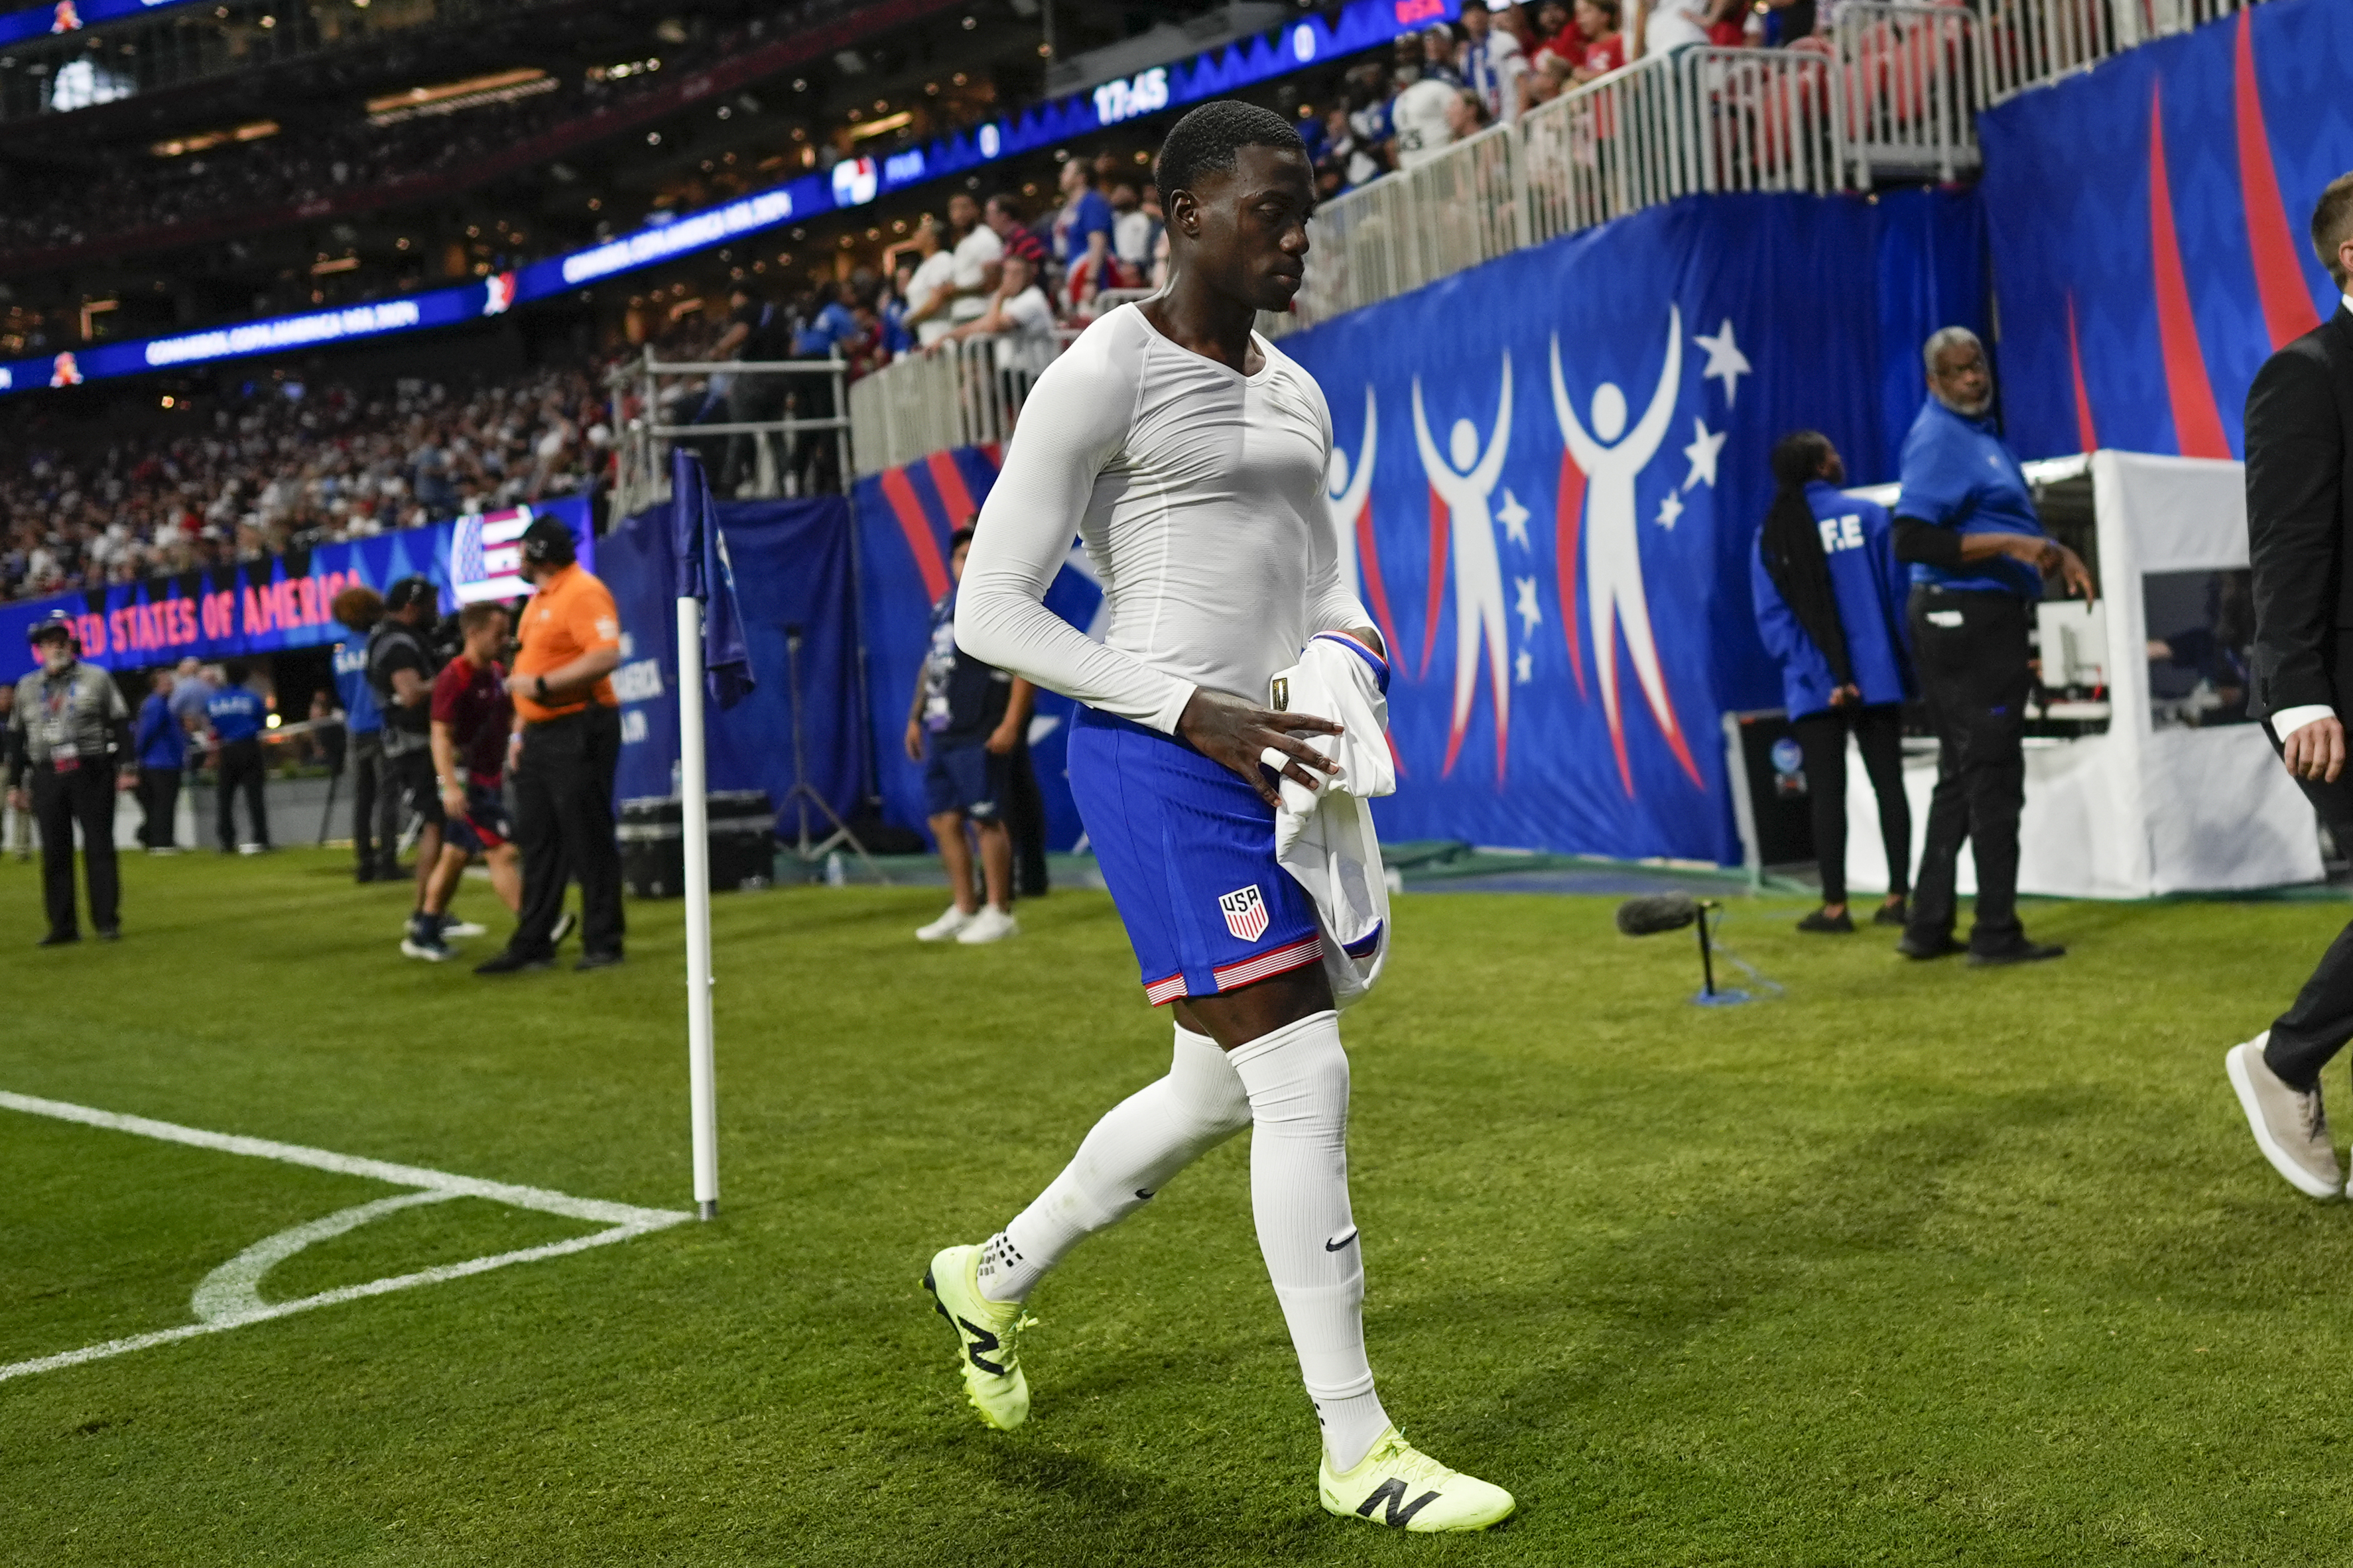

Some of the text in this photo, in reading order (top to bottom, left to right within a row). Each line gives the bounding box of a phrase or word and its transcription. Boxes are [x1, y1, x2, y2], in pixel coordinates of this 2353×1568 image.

[1093, 67, 1169, 125] 17:45
[1293, 24, 1316, 62] 0
[109, 597, 197, 654] STATES
[202, 589, 235, 640] OF
[243, 568, 361, 636] AMERI
[1222, 888, 1258, 912] USA
